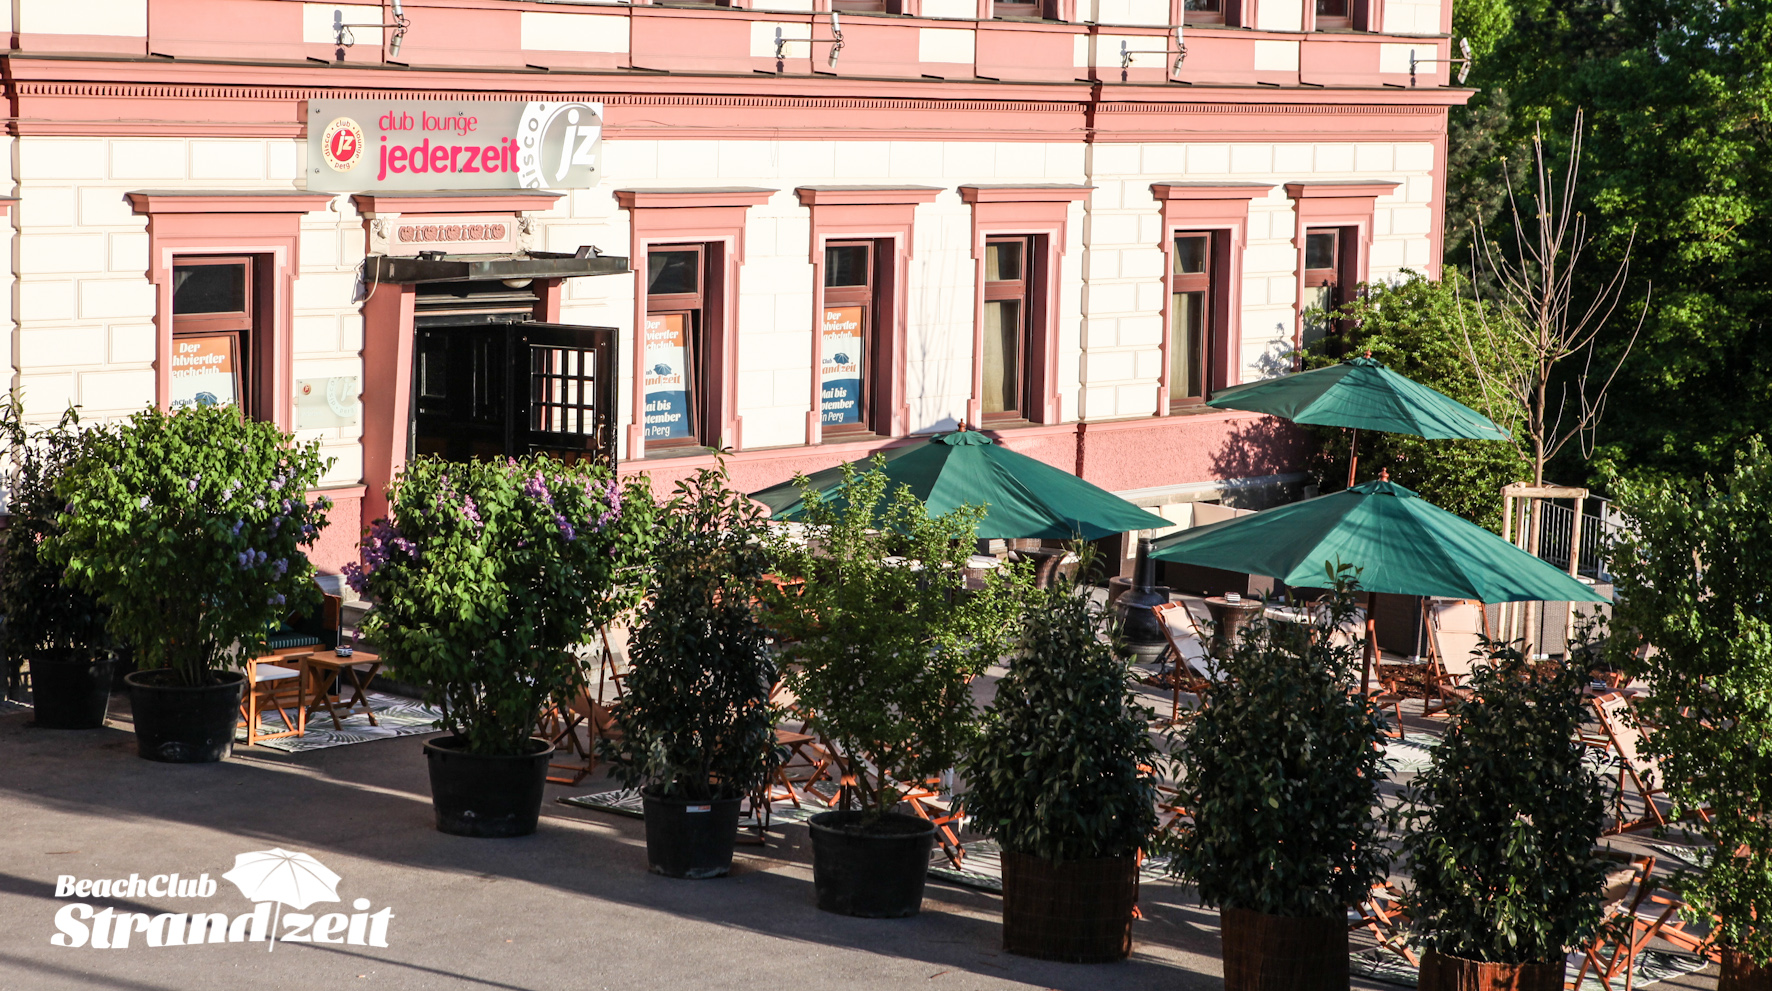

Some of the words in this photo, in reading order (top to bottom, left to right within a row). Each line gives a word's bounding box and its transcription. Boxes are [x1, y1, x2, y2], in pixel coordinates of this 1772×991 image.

[336, 120, 351, 128] club
[378, 110, 415, 131] club
[422, 110, 478, 136] lounge
[336, 129, 354, 156] jz
[555, 108, 601, 182] jz
[377, 135, 520, 182] jederzeit
[334, 162, 351, 170] perg
[826, 311, 842, 321] Der
[179, 342, 201, 353] Der
[835, 386, 847, 398] bis
[657, 399, 672, 411] bis
[828, 411, 844, 423] Perg
[651, 425, 670, 437] Perg
